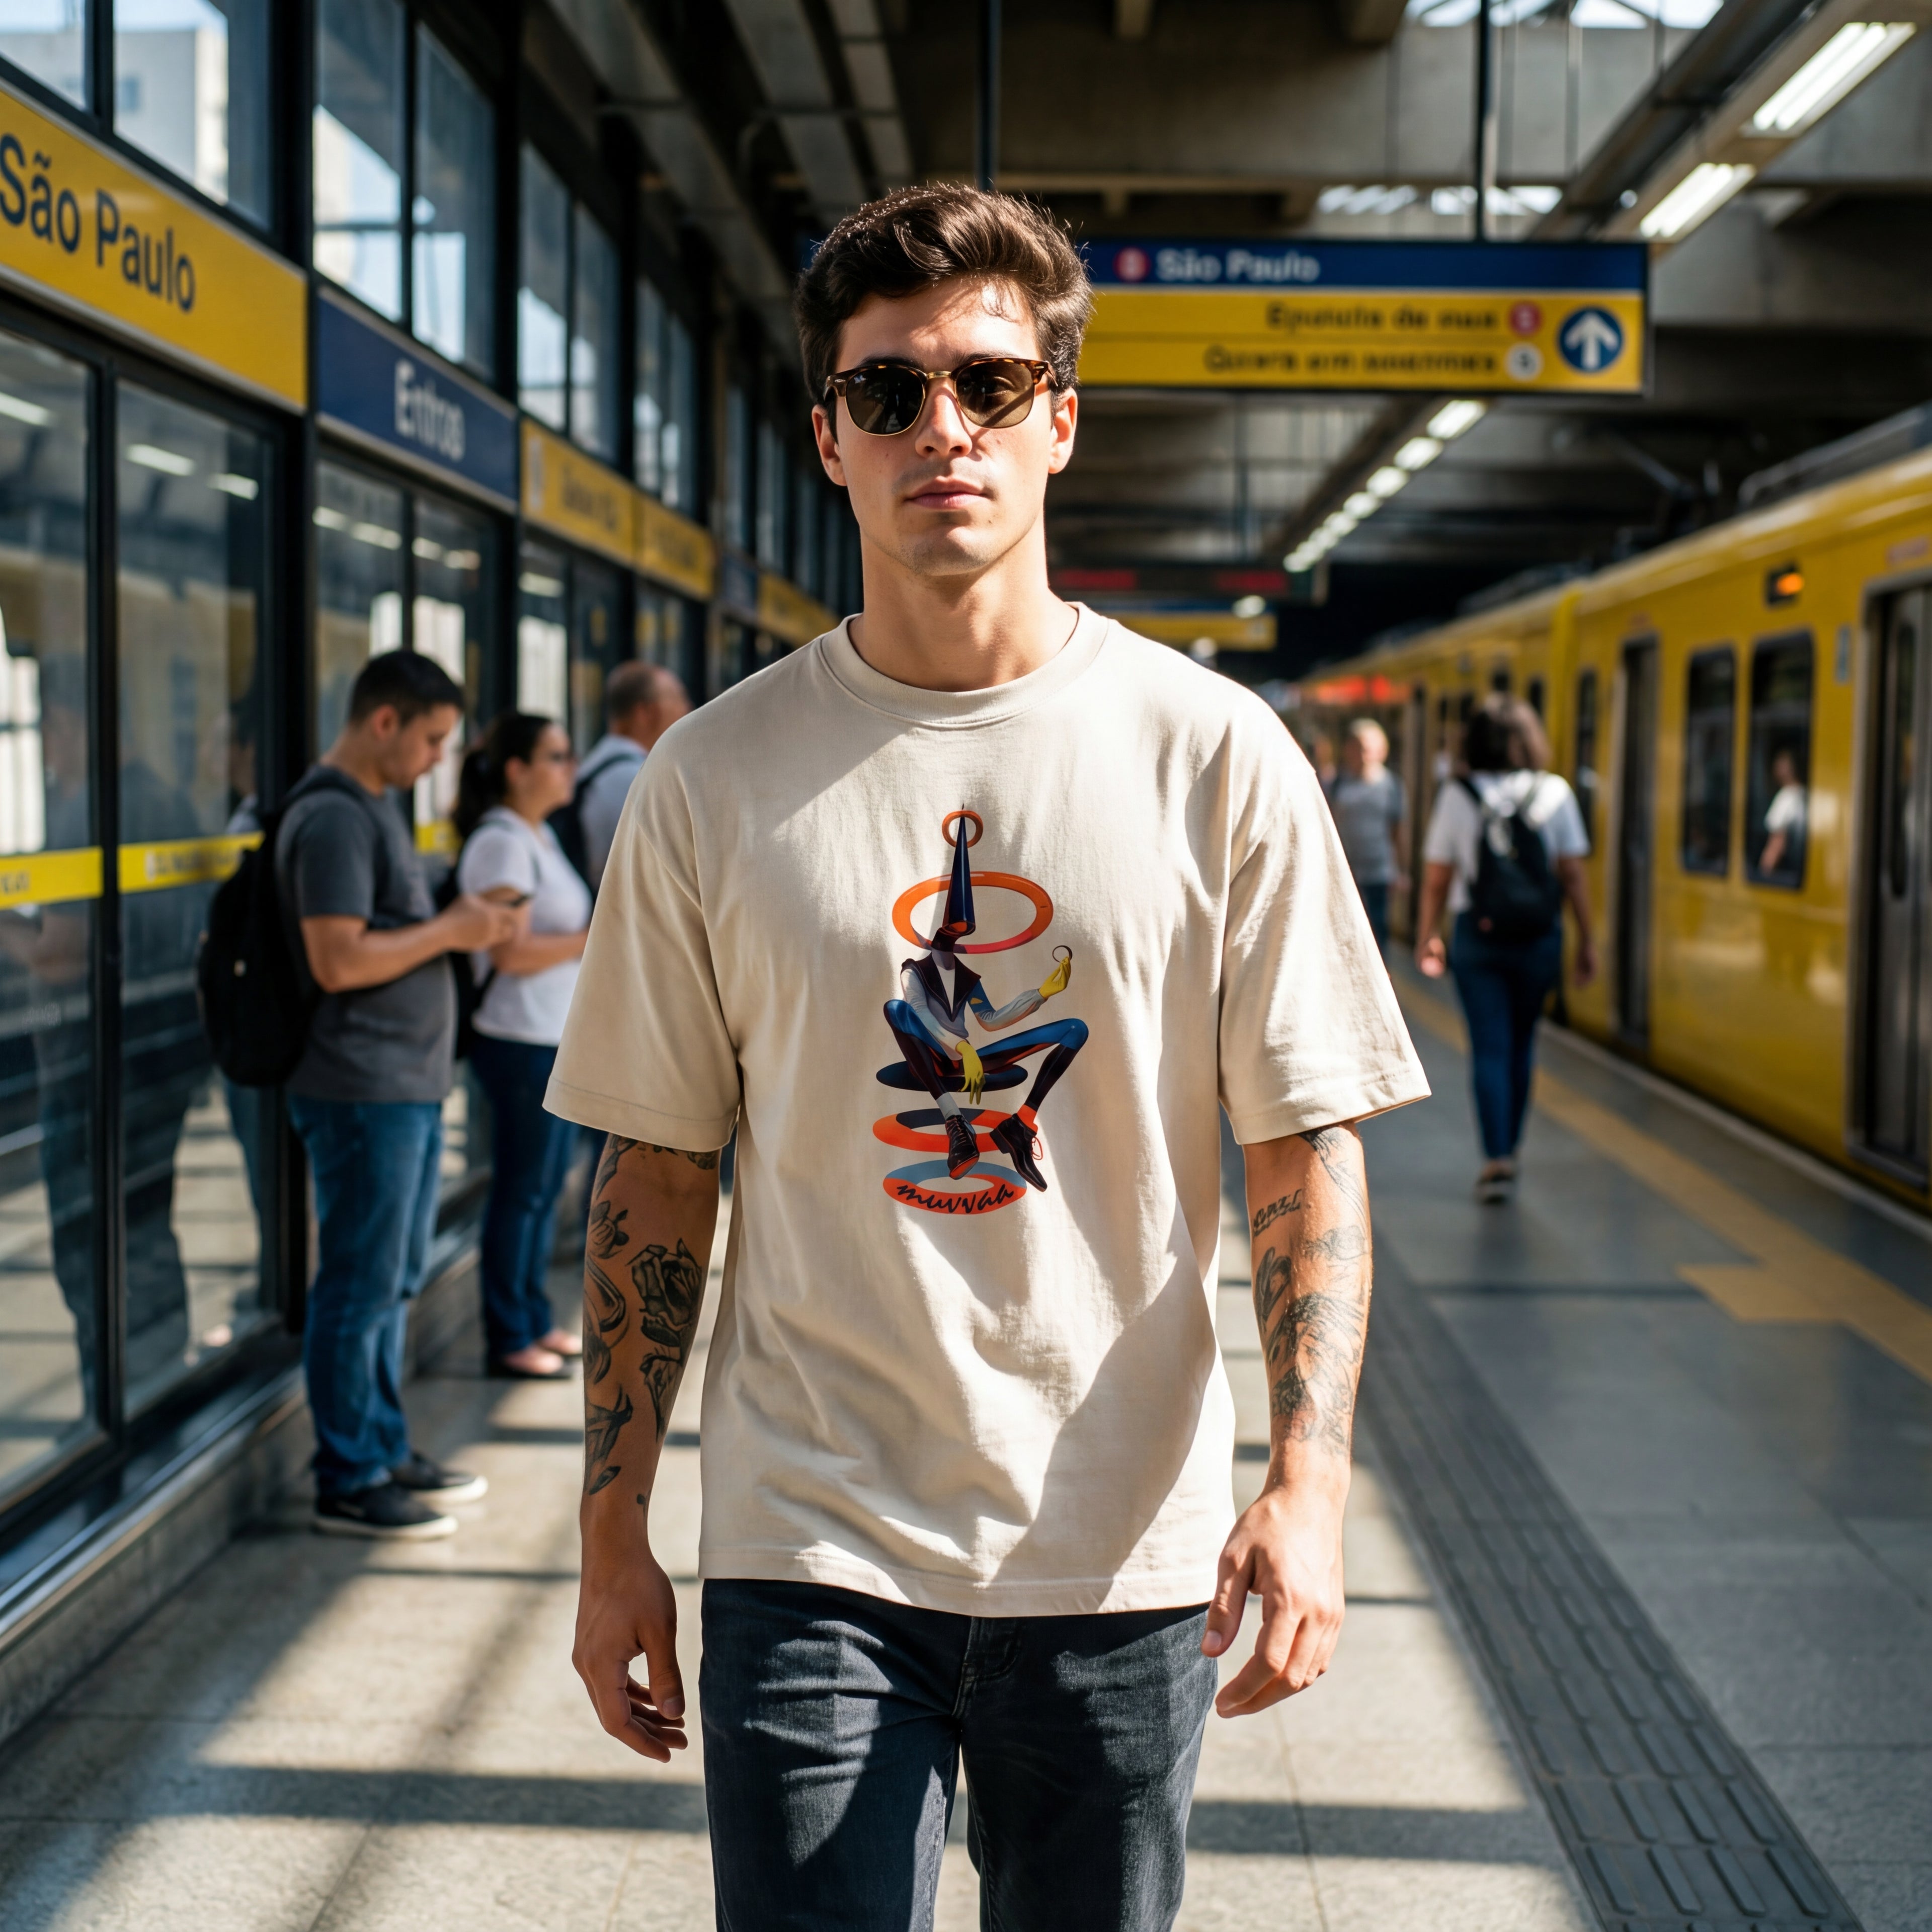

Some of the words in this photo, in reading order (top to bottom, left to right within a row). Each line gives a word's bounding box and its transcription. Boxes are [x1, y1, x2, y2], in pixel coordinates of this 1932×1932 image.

[0, 133, 81, 255] São
[97, 188, 196, 314] Paulo
[1157, 248, 1221, 282] São
[1226, 249, 1320, 283] Paulo
